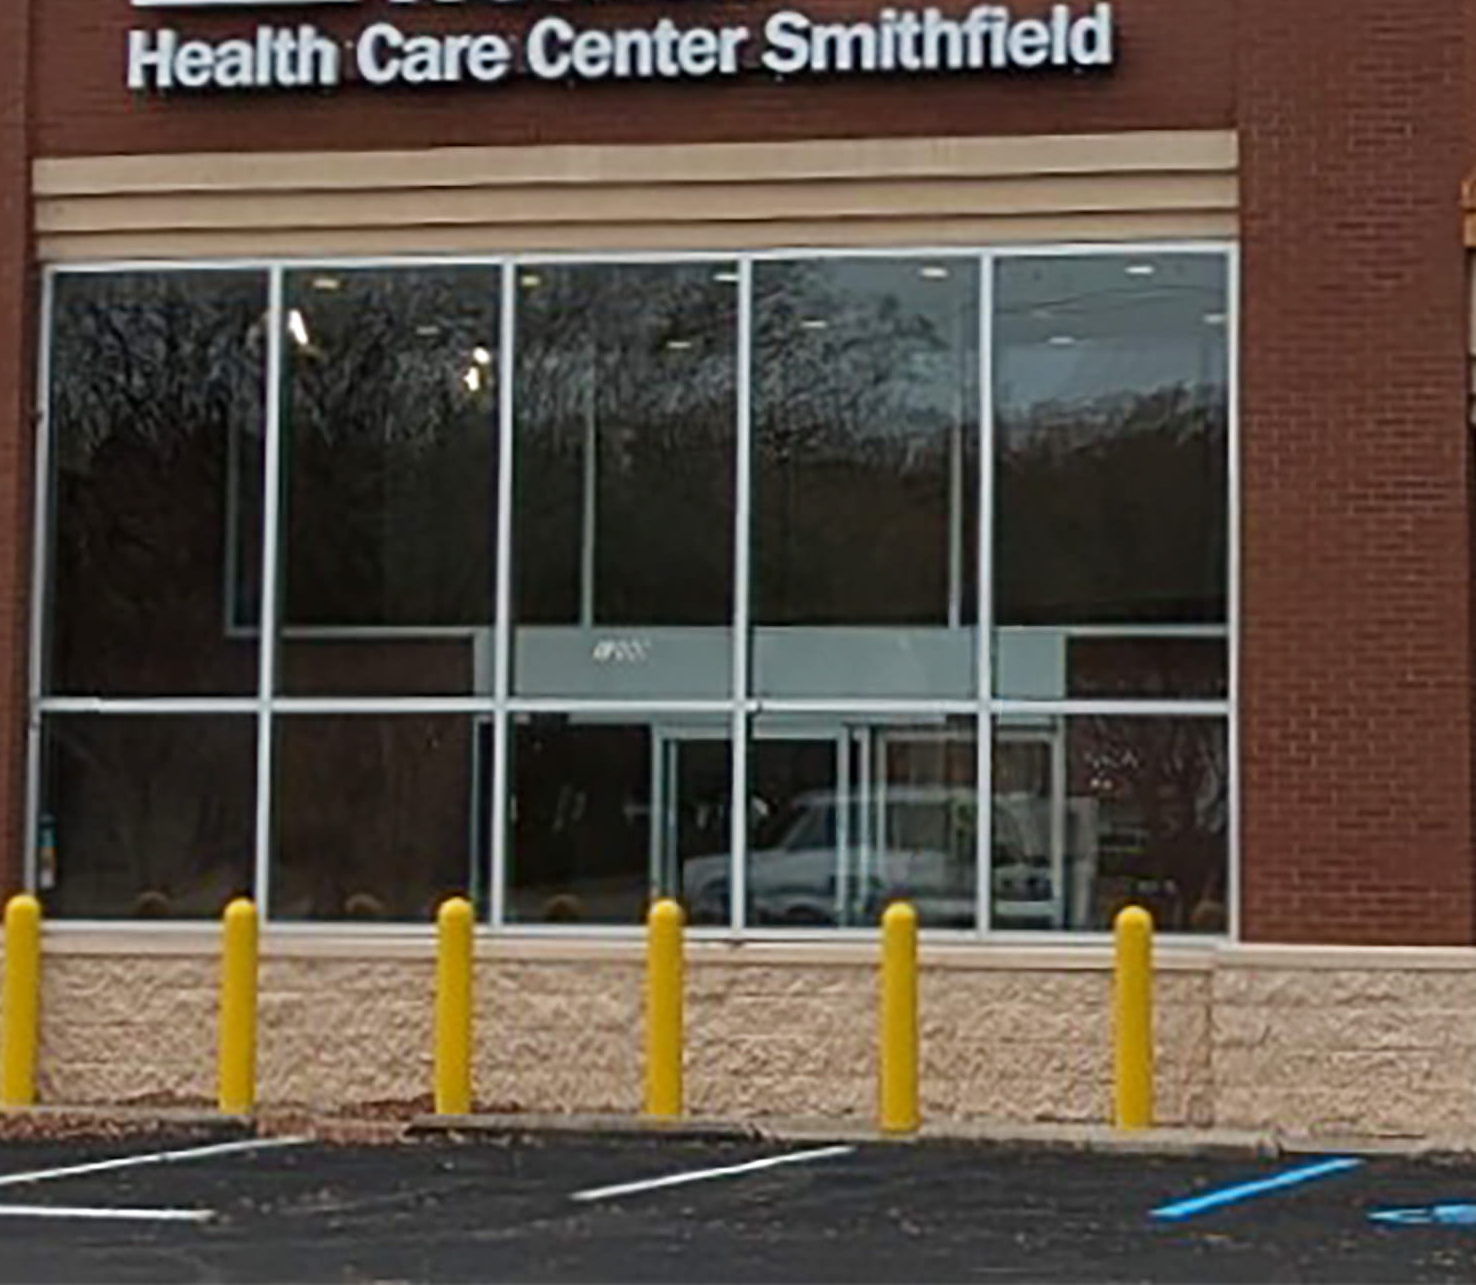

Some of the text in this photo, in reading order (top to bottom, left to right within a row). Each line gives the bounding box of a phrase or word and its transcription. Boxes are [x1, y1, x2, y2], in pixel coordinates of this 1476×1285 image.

[126, 1, 1114, 89] Health Care Center Smithfield
